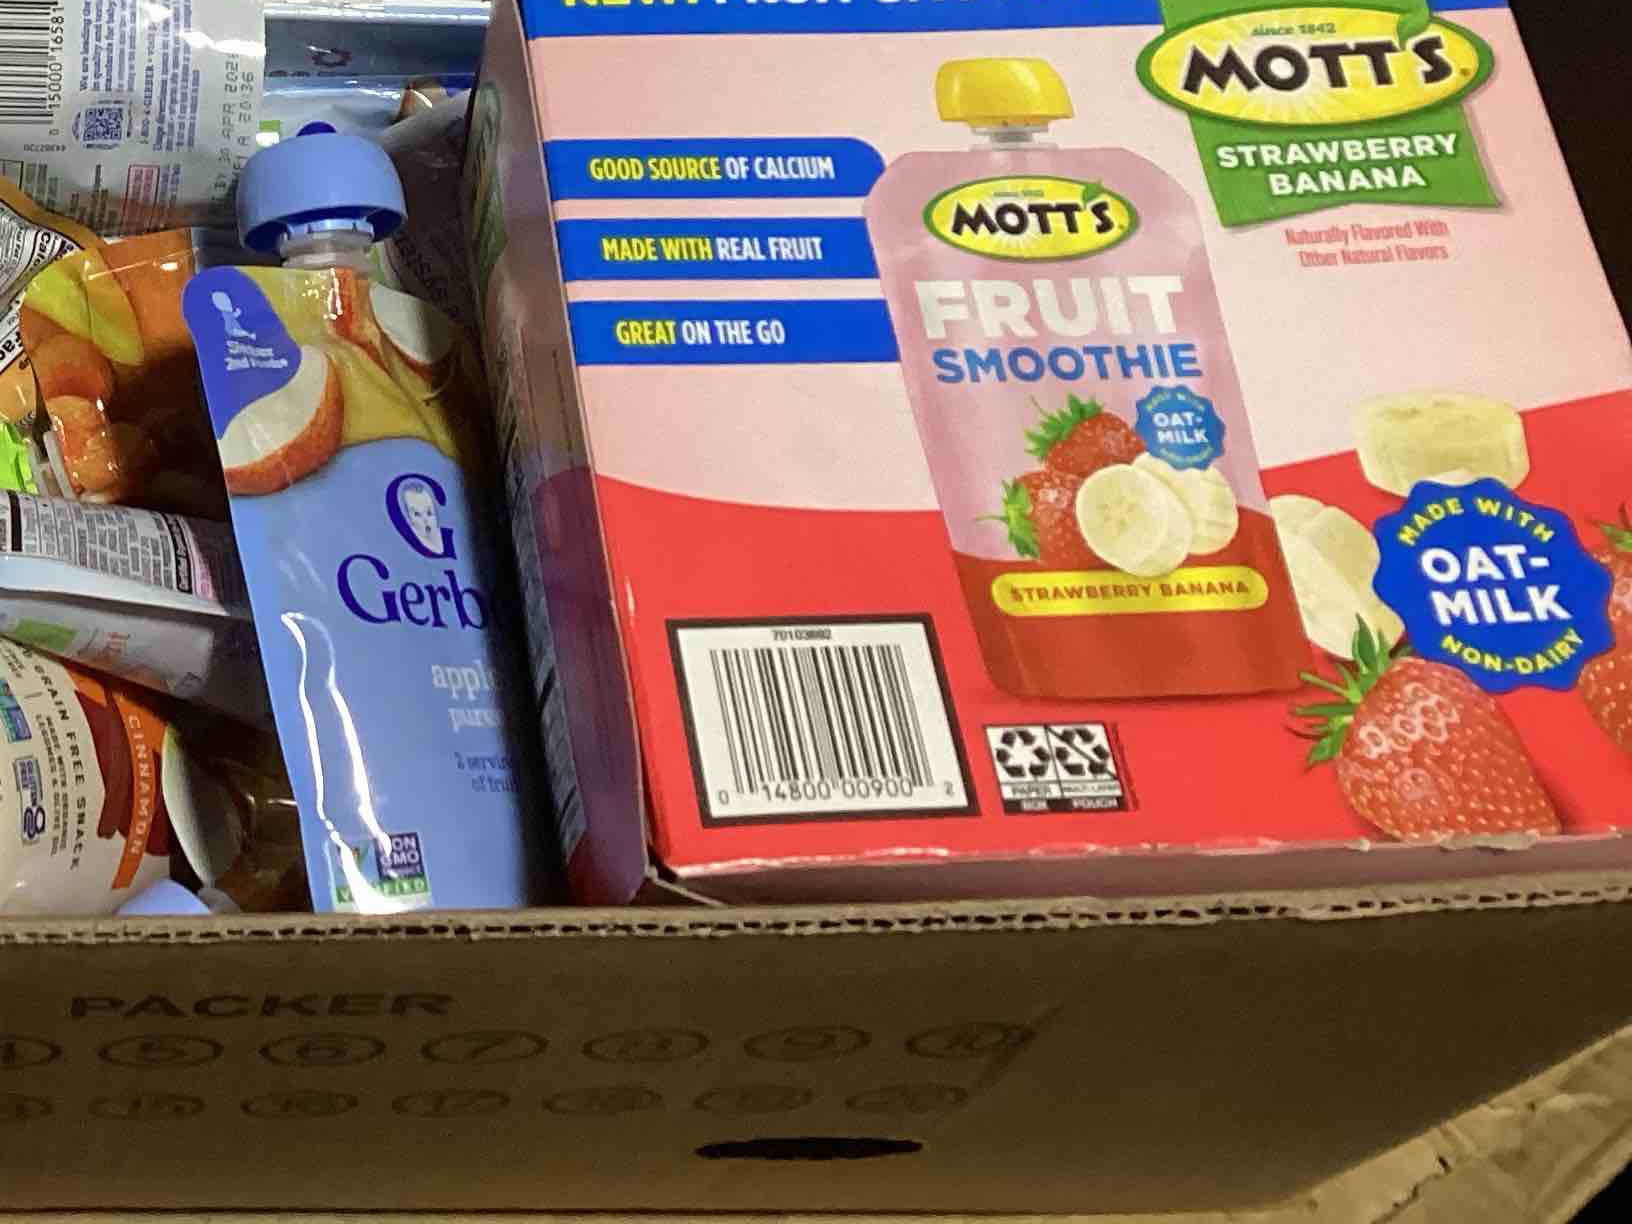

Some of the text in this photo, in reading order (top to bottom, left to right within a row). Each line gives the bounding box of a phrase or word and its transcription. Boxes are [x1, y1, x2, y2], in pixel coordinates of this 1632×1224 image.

[1252, 24, 1295, 36] since
[47, 6, 65, 110] 15000 16581
[1215, 133, 1457, 169] STRAWBERRY
[589, 156, 836, 180] GOOD SOURCE OF CALCIUM
[1267, 165, 1428, 196] BANANA
[1285, 219, 1448, 246] Naturally Flavored With
[602, 236, 824, 261] MADE WITH REAL FRUIT
[1298, 244, 1449, 267] Other Natural Flavors
[914, 275, 1184, 340] FRUIT
[615, 320, 786, 345] GREAT ON THE GO
[932, 342, 1203, 384] SMOOTHIE
[1153, 411, 1204, 427] OAT-
[1157, 429, 1209, 444] MILK
[1396, 497, 1556, 547] MADE WITH
[1420, 544, 1550, 584] OAT-
[1009, 580, 1249, 603] STRAWBERRY BANANA
[1430, 584, 1573, 626] MILK
[1441, 628, 1584, 674] NON-DAIRY
[33, 665, 70, 722] GRAIN
[65, 731, 86, 786] FREE
[44, 715, 60, 750] MADE
[54, 755, 66, 789] WITH
[127, 714, 150, 856] CINNAMON
[762, 780, 832, 803] 14800
[841, 778, 914, 799] 00900
[70, 995, 456, 1017] PACKER
